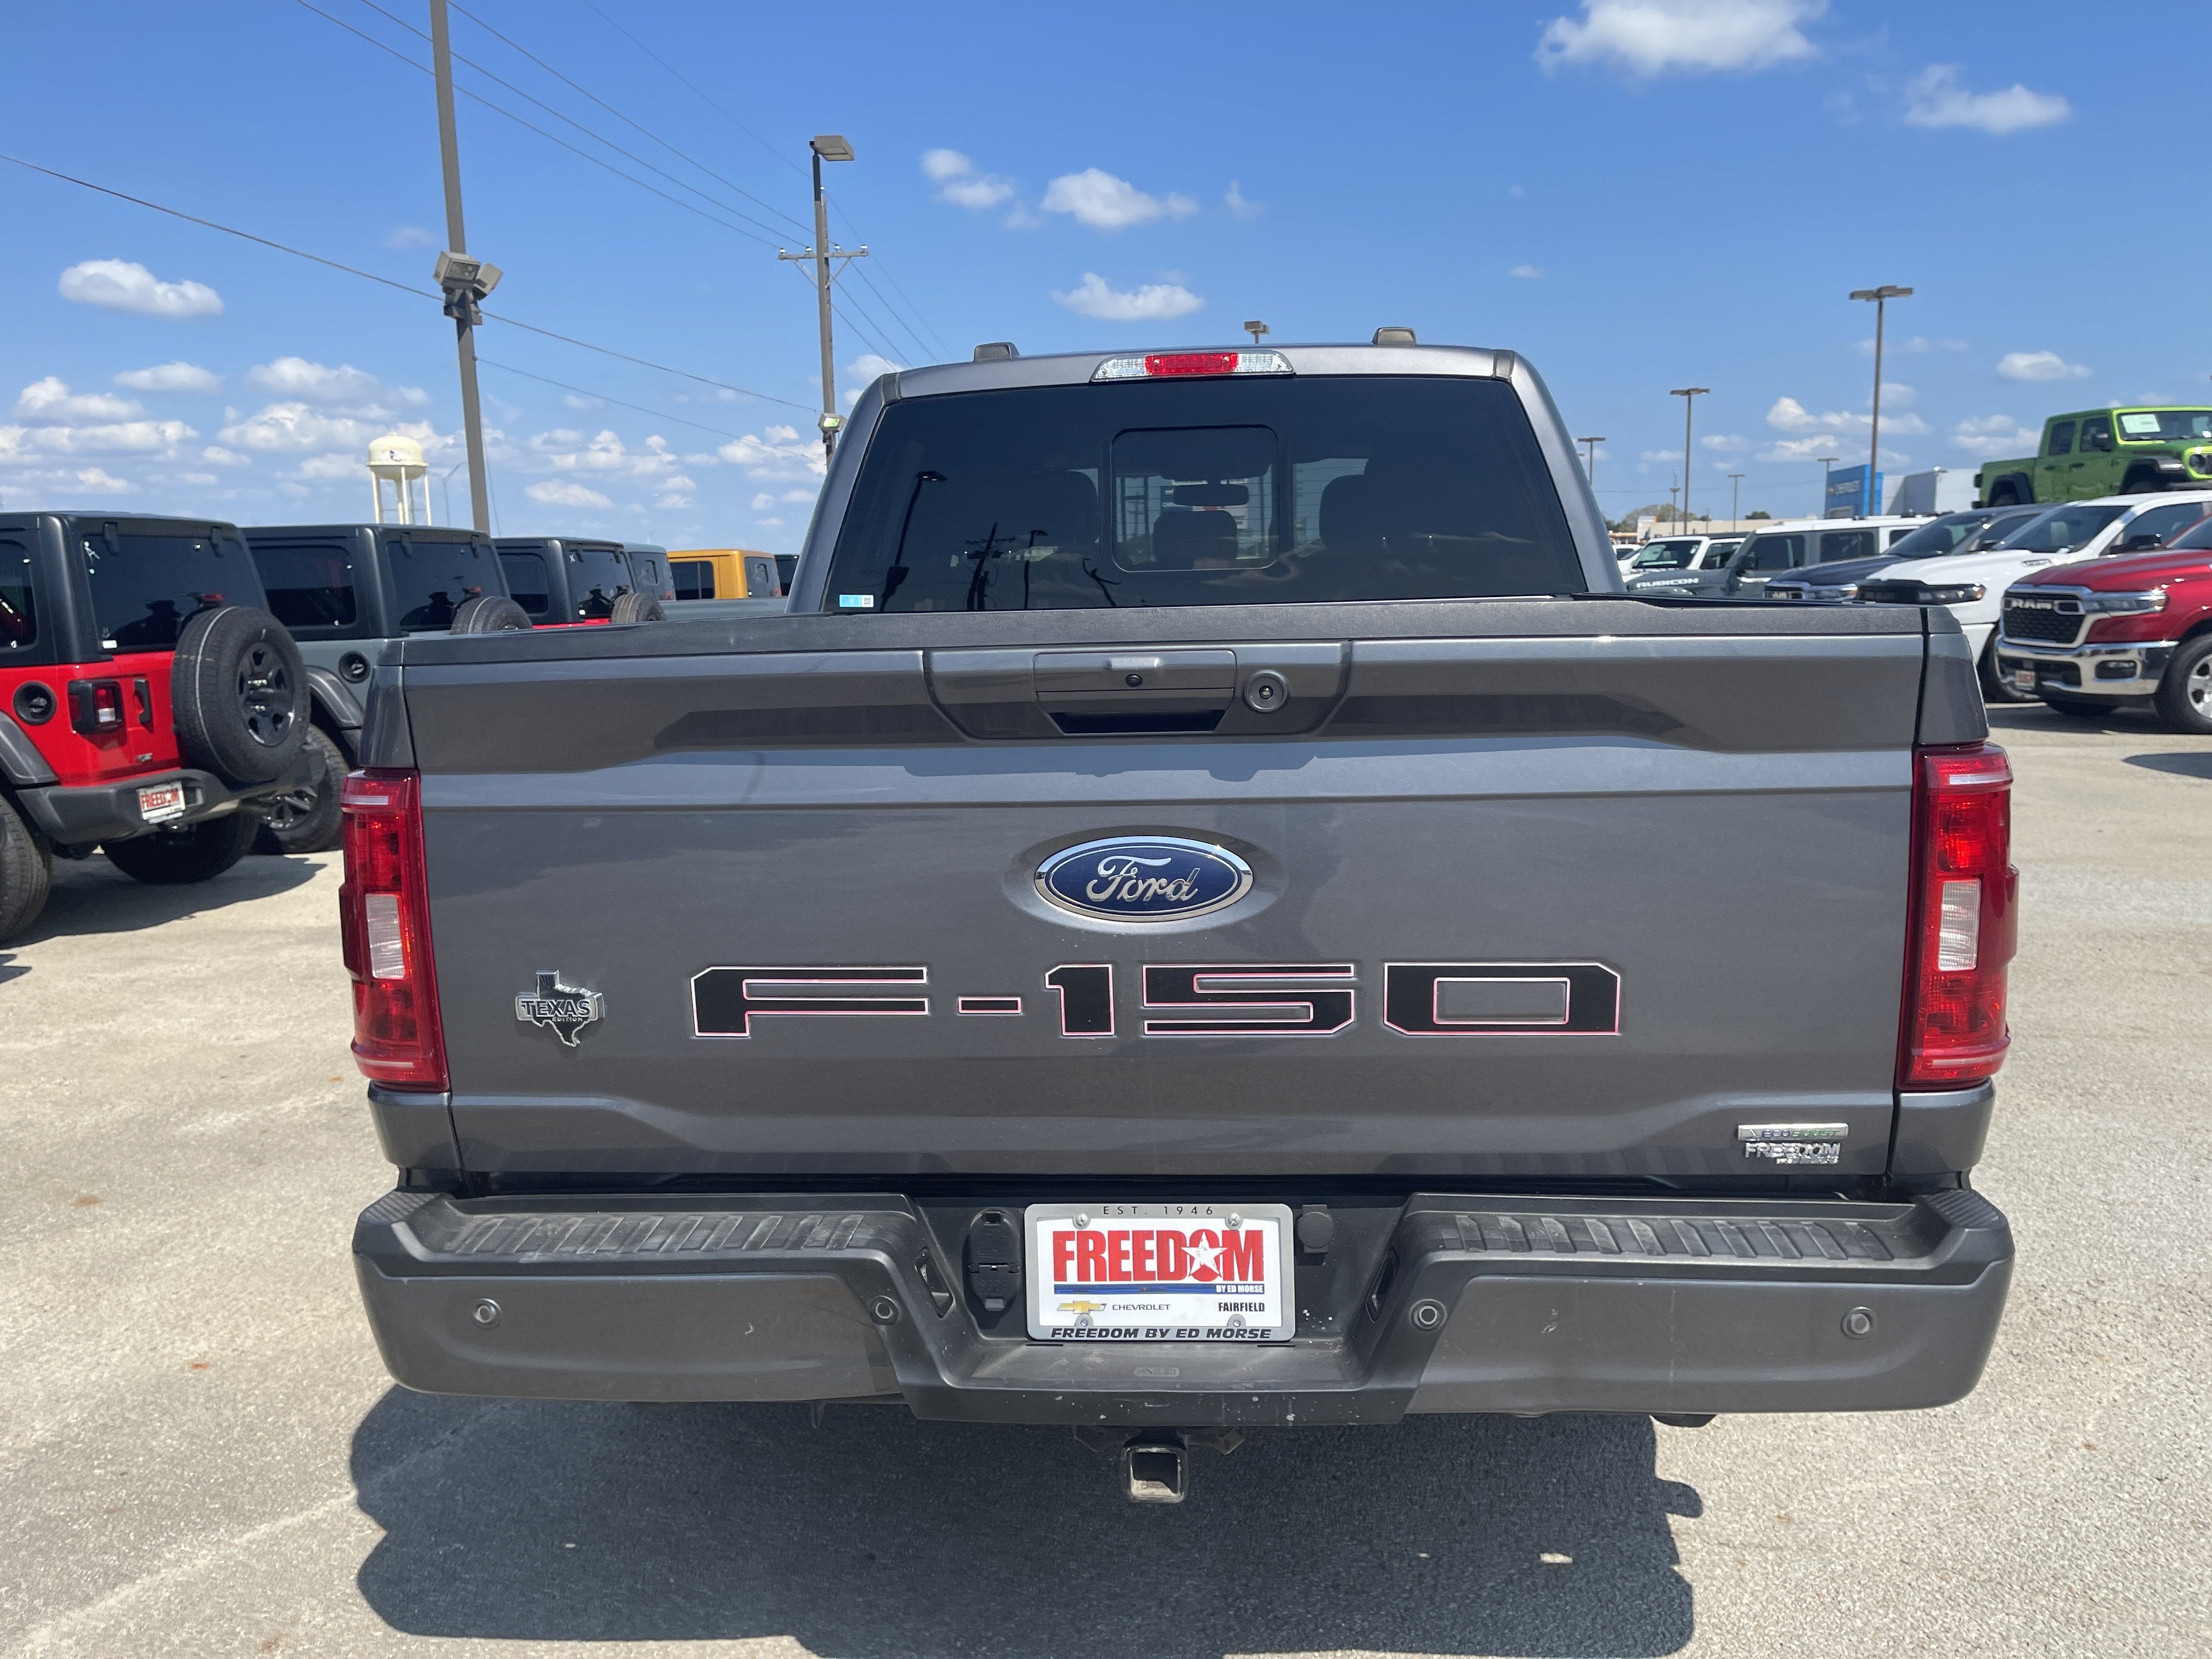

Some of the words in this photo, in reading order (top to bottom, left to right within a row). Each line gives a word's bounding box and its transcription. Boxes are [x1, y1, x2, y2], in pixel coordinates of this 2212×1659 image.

[1637, 578, 1699, 588] RUBICON
[2010, 599, 2052, 610] RAM
[140, 788, 179, 810] FREEDOM
[1086, 855, 1200, 902] Ford
[690, 963, 1621, 1037] F-150
[521, 999, 591, 1017] TEXAS
[1762, 1129, 1841, 1138] ECOBOOST
[1745, 1142, 1841, 1158] FREEDOM
[1103, 1206, 1147, 1215] EST.
[1164, 1206, 1212, 1215] 1946
[1053, 1229, 1265, 1282] FREEDOM
[1216, 1285, 1226, 1293] BY
[1227, 1285, 1237, 1293] ED
[1238, 1285, 1263, 1293] MORSE
[1218, 1302, 1265, 1312] FAIRFIELD
[1051, 1328, 1139, 1339] FREEDOM
[1145, 1328, 1171, 1339] BY
[1176, 1328, 1200, 1339] ED
[1206, 1328, 1272, 1339] MORSE
